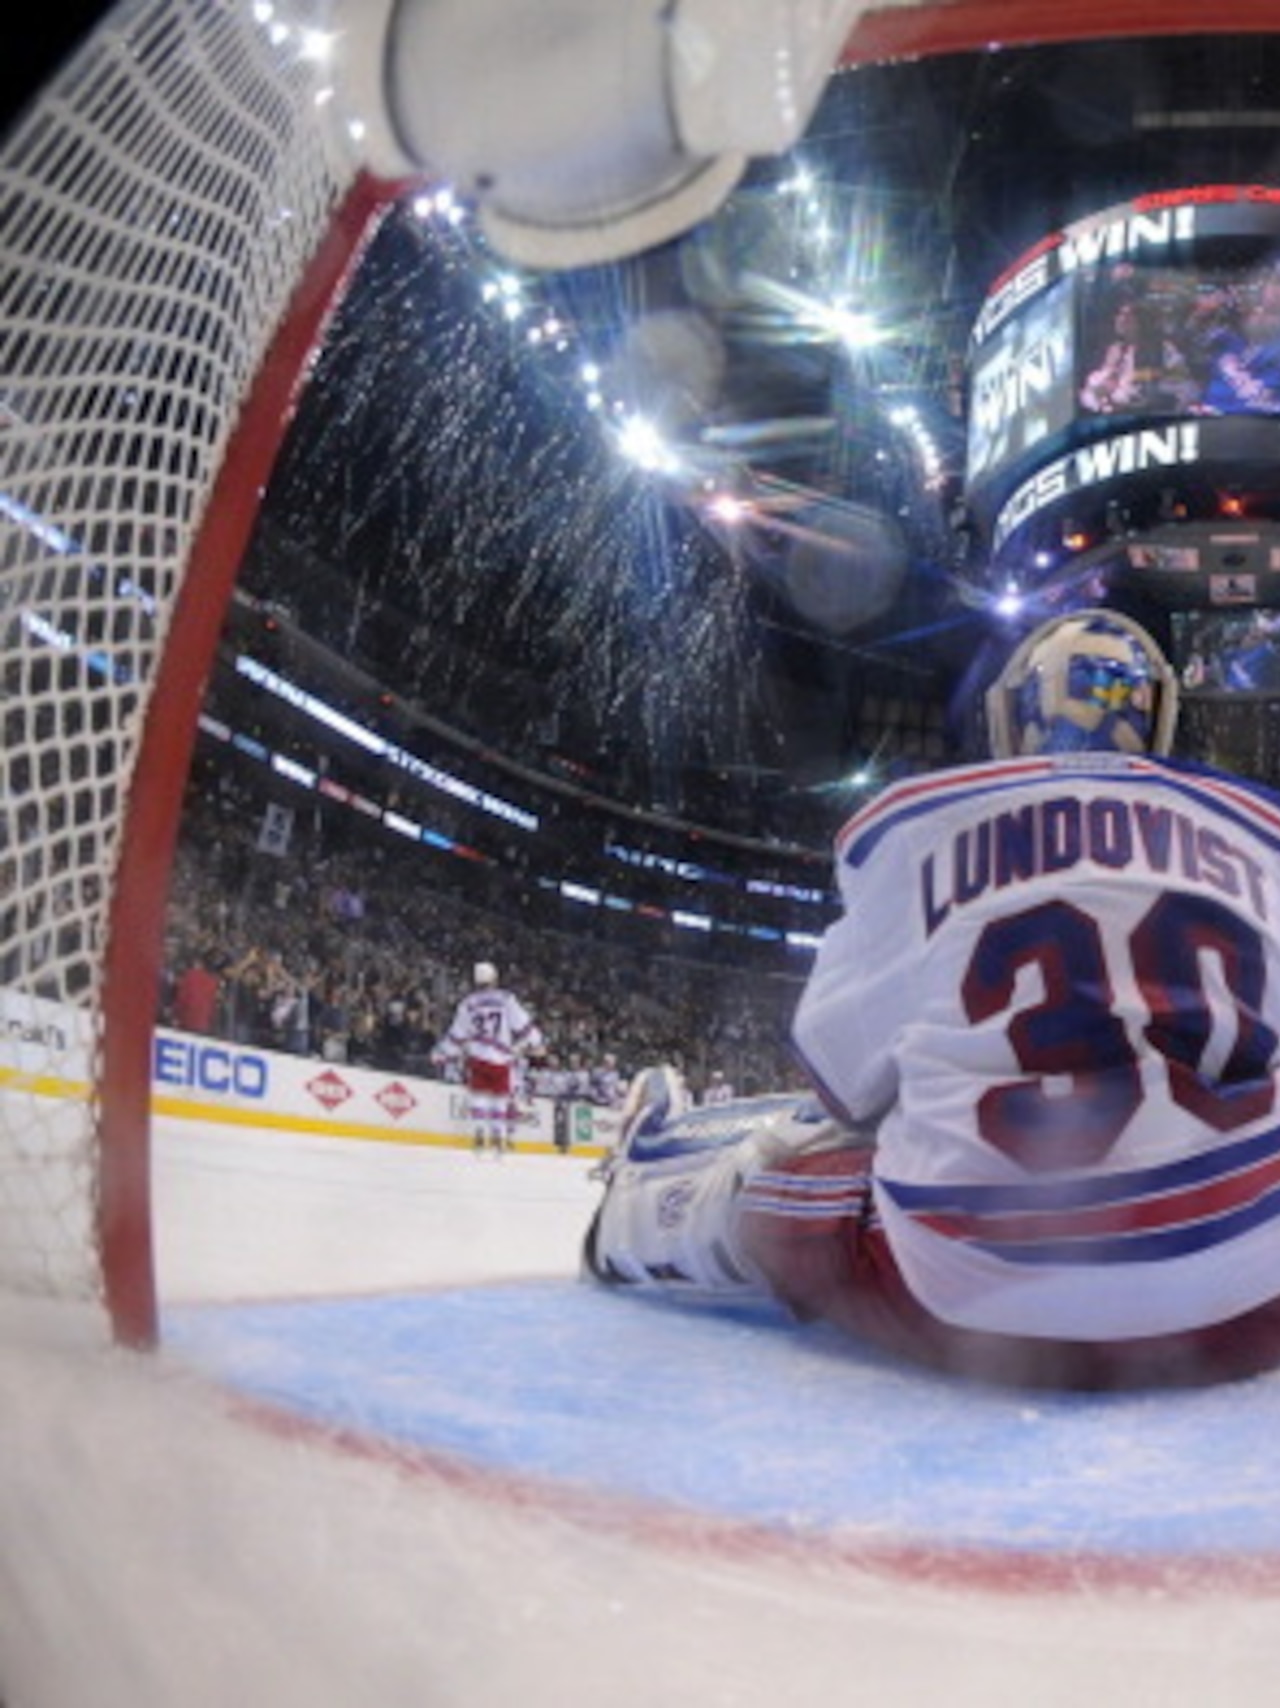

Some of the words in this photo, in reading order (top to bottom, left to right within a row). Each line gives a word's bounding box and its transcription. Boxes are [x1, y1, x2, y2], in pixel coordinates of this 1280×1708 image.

[1058, 204, 1196, 272] WIN!
[1075, 422, 1199, 485] WIN!
[959, 888, 1280, 1174] 30
